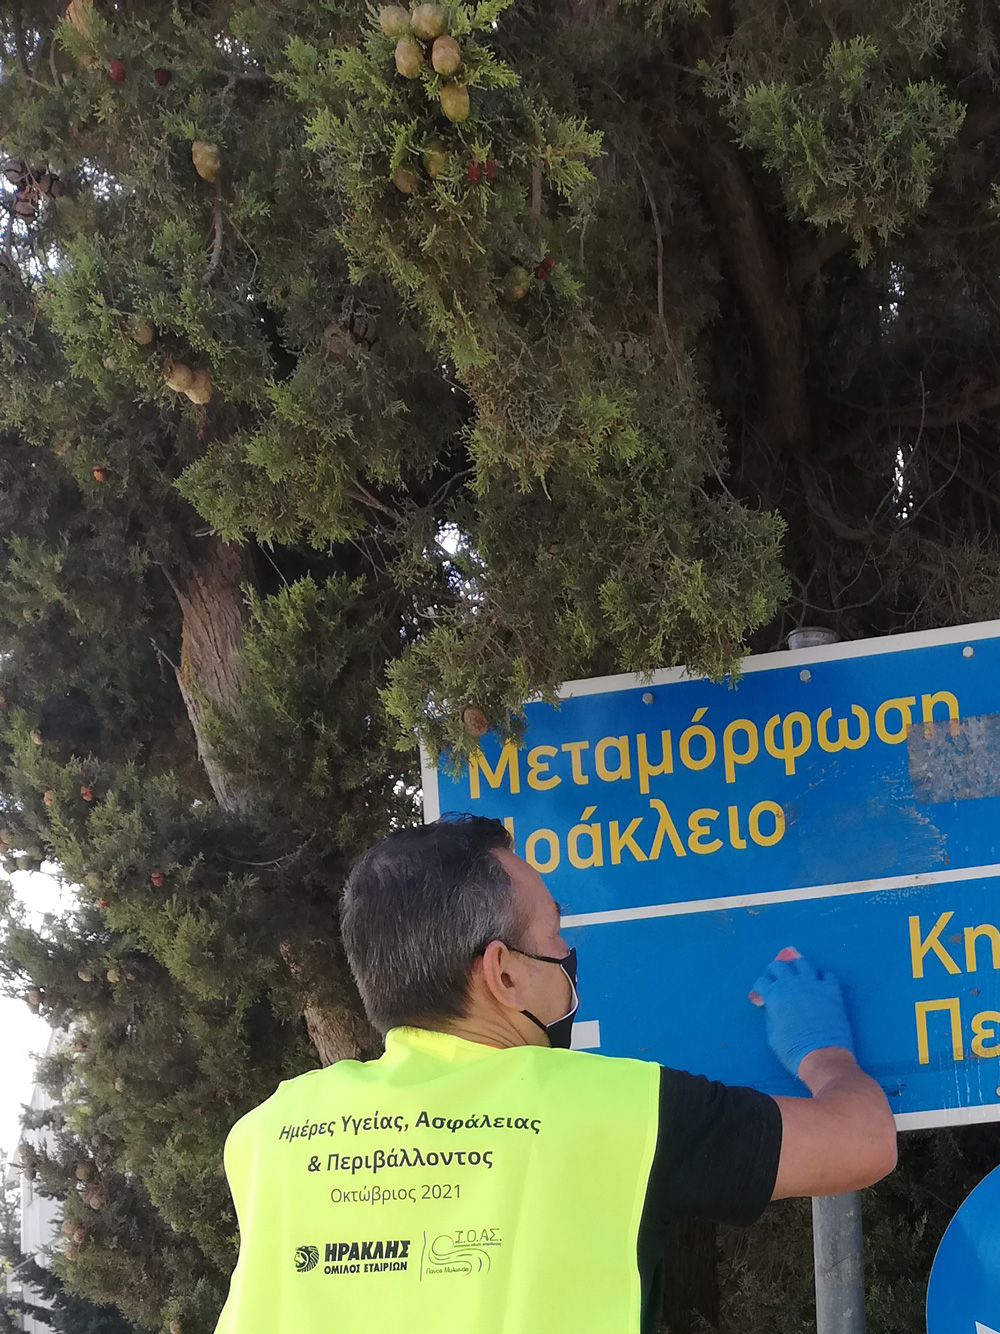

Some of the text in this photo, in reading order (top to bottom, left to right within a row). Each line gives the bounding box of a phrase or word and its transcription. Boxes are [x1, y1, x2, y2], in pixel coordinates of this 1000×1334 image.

[468, 690, 961, 799] Μεταμόρφωση
[278, 1110, 542, 1143] Ημέρες Υγείας, Ασφάλειας
[307, 1147, 493, 1175] & Περιβάλλοντος
[330, 1184, 462, 1206] Οκτώβριος 2021
[324, 1240, 411, 1262] ΗΡΑΚΛΗΣ
[324, 1261, 408, 1275] ΟΜΙΛΟΣ ΕΤΑΙΡΙΩΝ
